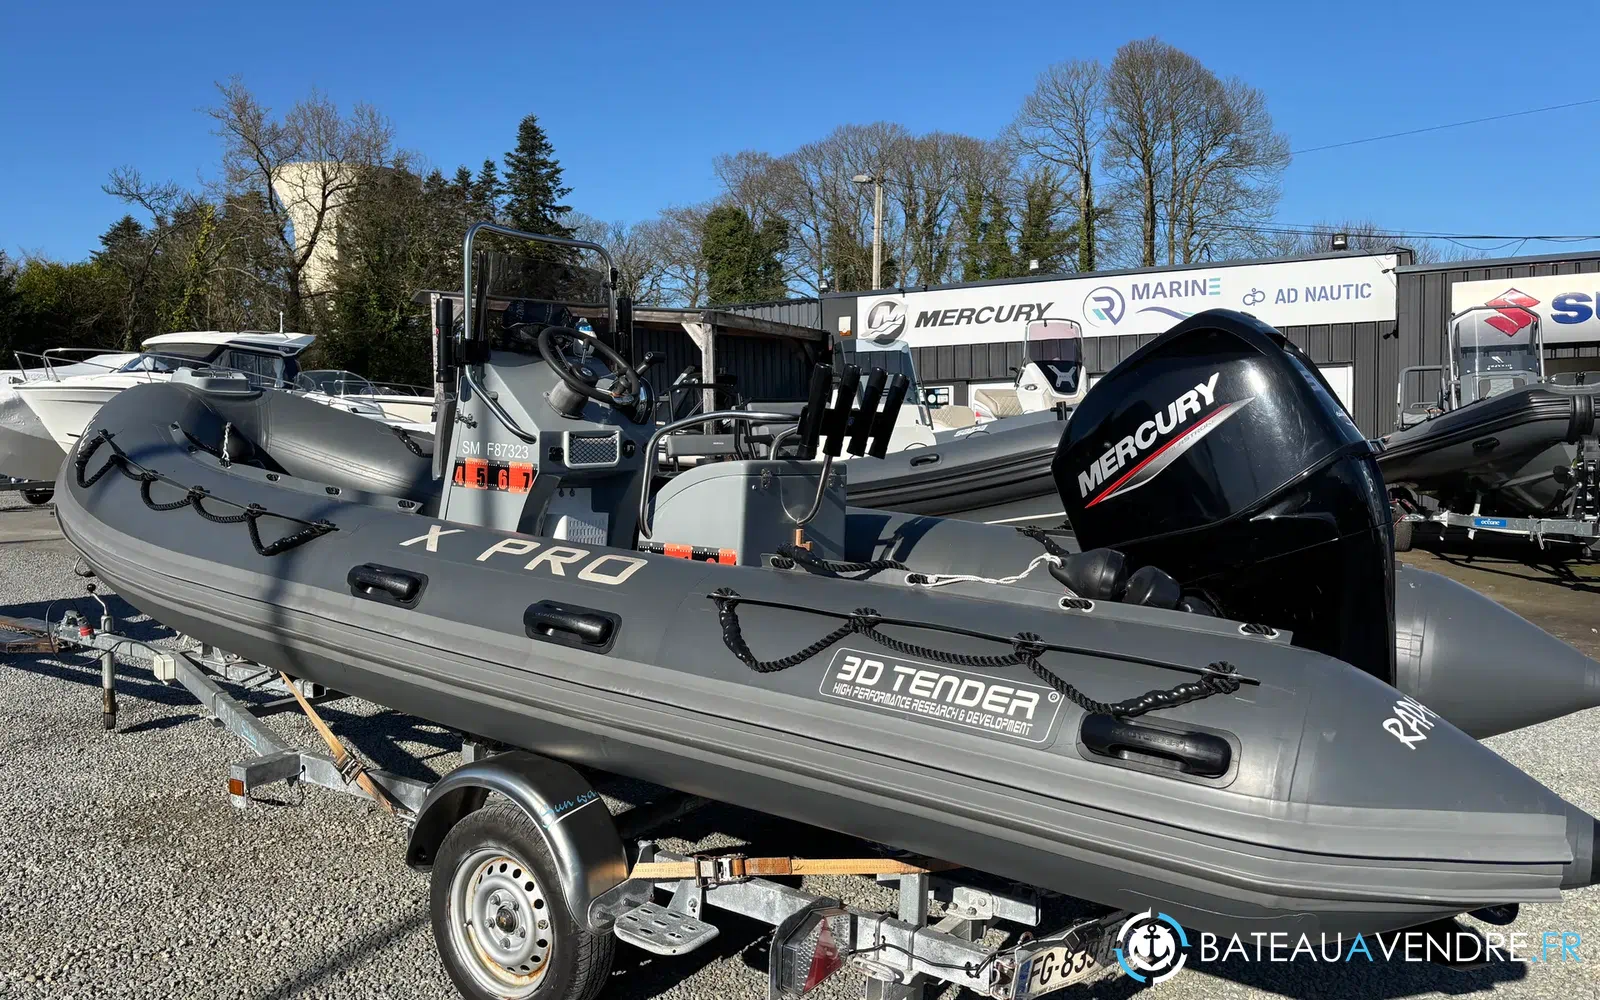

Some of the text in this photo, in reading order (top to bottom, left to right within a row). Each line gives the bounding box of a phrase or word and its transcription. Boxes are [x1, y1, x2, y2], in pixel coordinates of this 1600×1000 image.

[1131, 277, 1221, 300] MARINE
[1274, 283, 1372, 304] AD NAUTIC
[914, 302, 1055, 328] MERCURY
[1551, 291, 1600, 325] S
[462, 440, 529, 459] SM F87323
[1077, 372, 1220, 498] MERCURY
[476, 467, 486, 488] 5
[498, 469, 508, 490] 6
[399, 524, 648, 585] X PRO
[836, 655, 1040, 720] 3D TENDER
[832, 682, 1034, 736] HIGH PERFORMANCE RESEARCH & DEVELOPMENT
